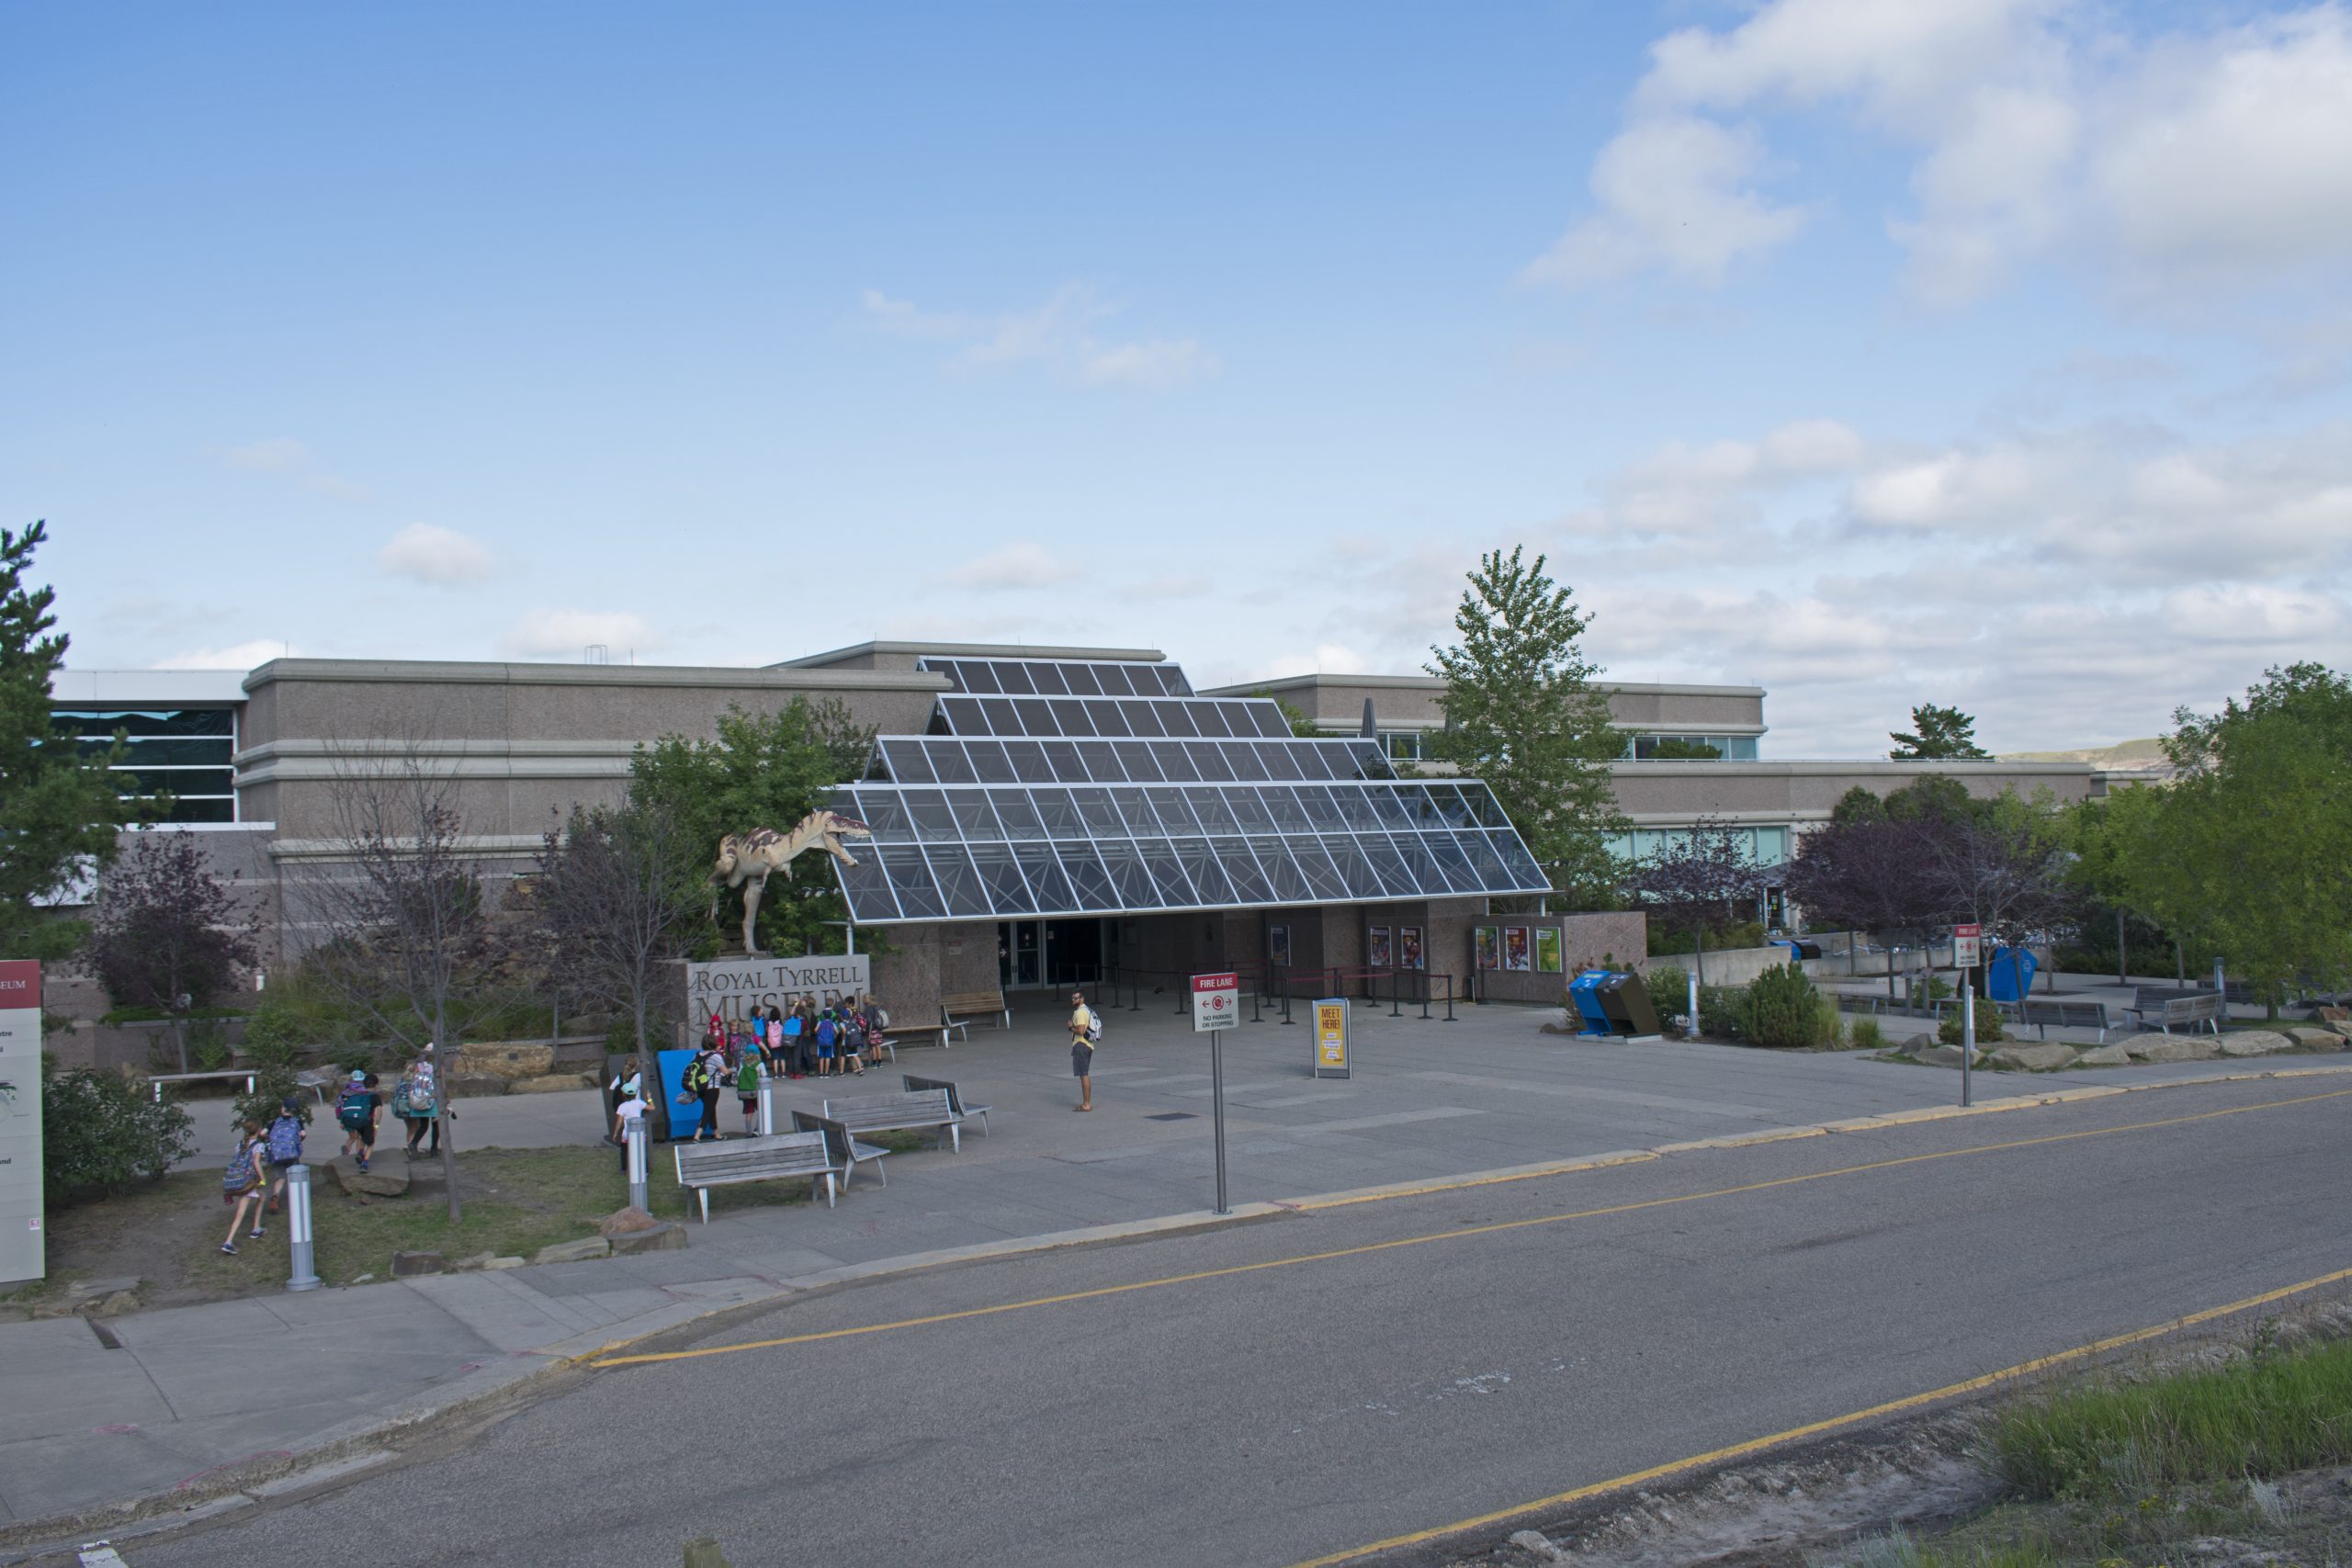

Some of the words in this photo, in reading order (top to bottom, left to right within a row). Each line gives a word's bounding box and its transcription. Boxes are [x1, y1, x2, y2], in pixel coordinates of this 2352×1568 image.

[695, 971, 768, 992] ROYAL
[773, 966, 864, 987] TYRRELL
[1200, 978, 1216, 988] FIRE
[1216, 977, 1233, 987] LANE
[695, 987, 864, 1026] MUSEM
[1321, 1008, 1340, 1019] MEET
[1322, 1019, 1340, 1030] HERE!
